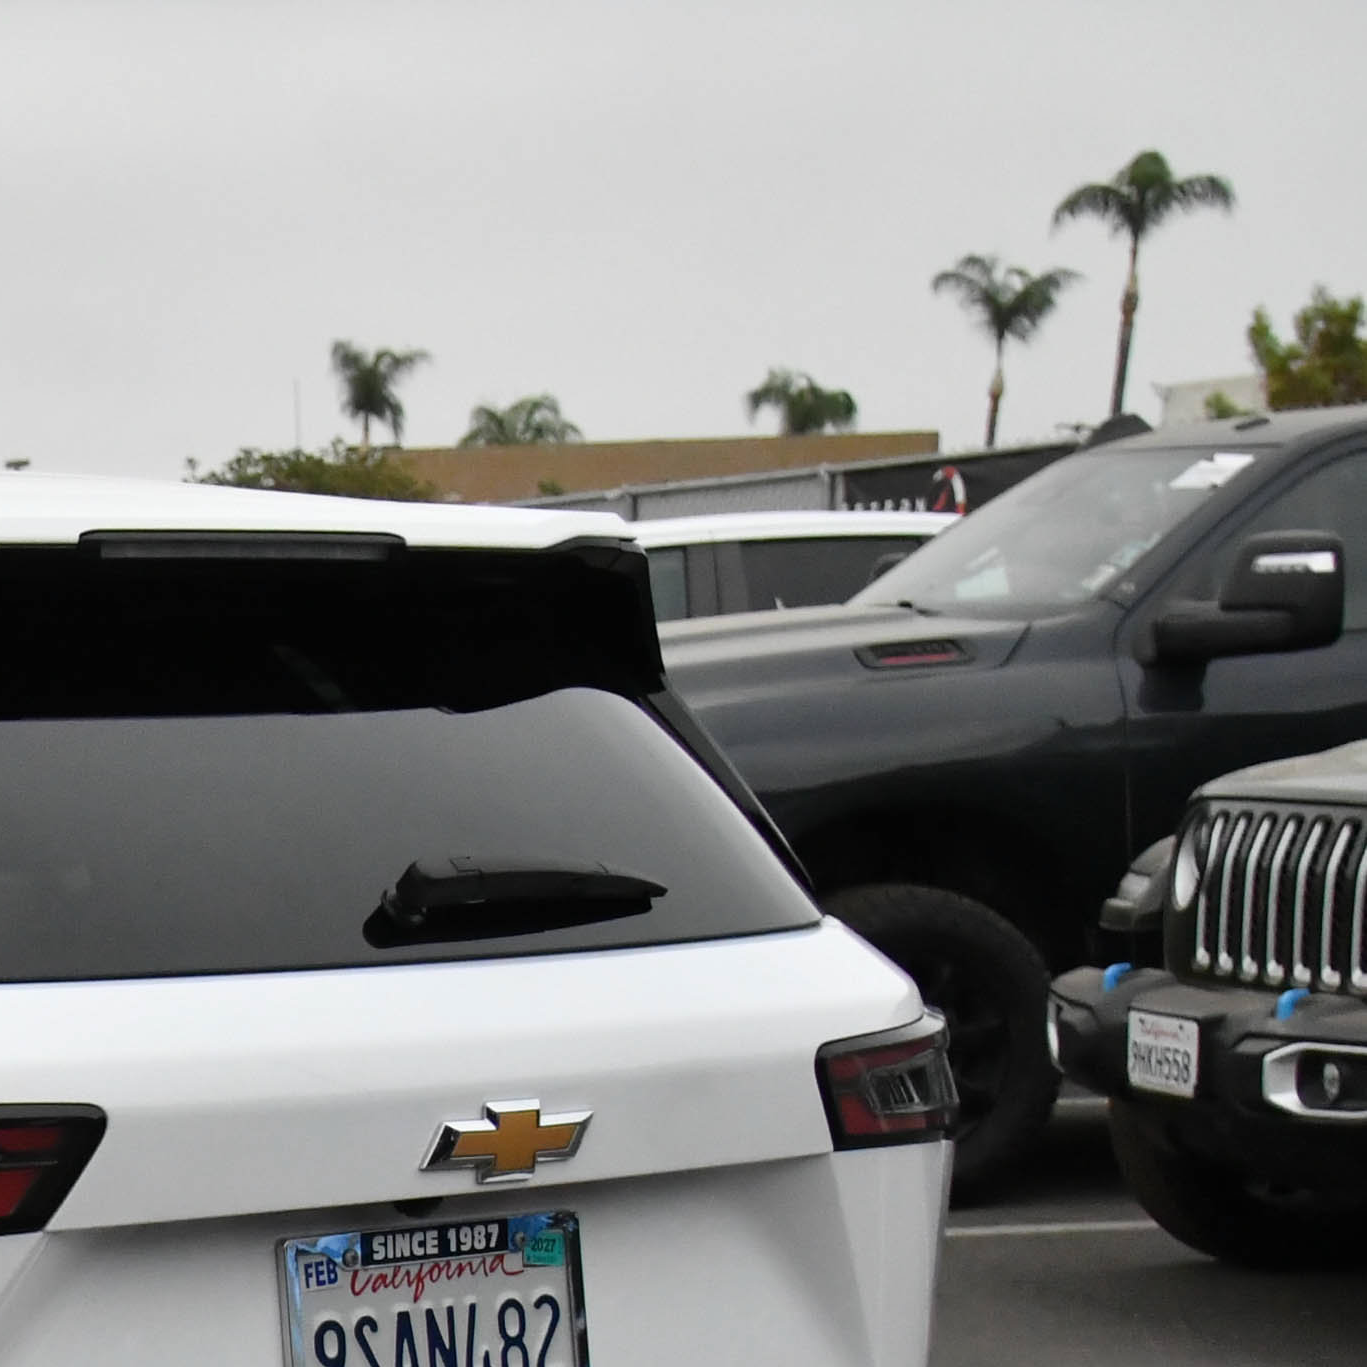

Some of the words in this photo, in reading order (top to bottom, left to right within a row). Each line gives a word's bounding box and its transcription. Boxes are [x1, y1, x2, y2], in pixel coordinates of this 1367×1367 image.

[371, 1230, 439, 1261] SINCE
[447, 1223, 500, 1253] 1987
[530, 1238, 556, 1252] 2027
[303, 1259, 339, 1289] FEB
[350, 1253, 524, 1303] California
